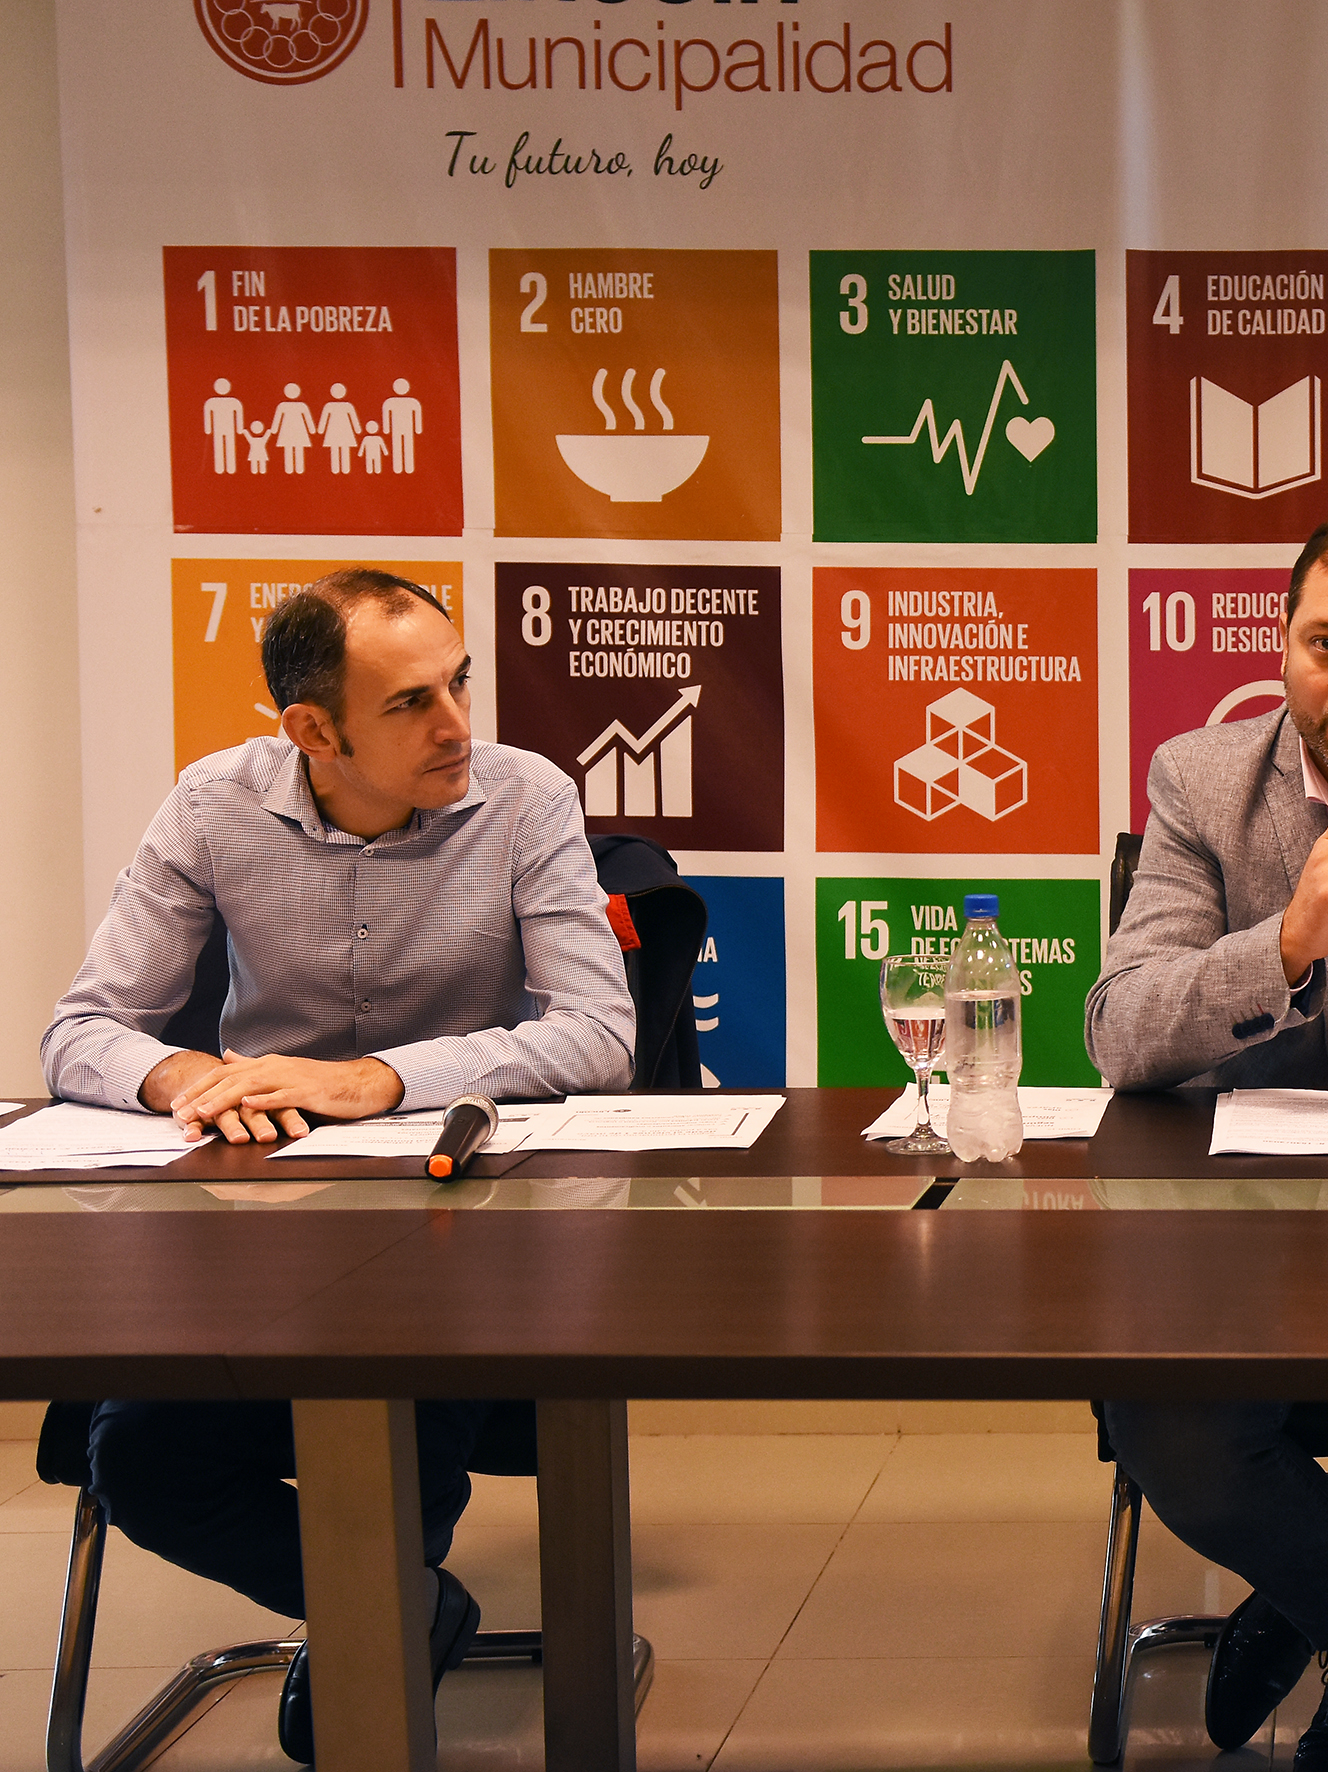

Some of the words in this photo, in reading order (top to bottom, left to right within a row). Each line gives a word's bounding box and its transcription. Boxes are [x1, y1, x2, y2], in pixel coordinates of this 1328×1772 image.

[424, 18, 954, 111] Municipalidad
[444, 130, 497, 177] Tu
[504, 130, 633, 189] futuro,
[653, 132, 724, 190] hoy
[232, 271, 266, 297] FIN
[569, 272, 655, 299] HAMBRE
[888, 274, 956, 301] SALUD
[1207, 270, 1324, 301] EDUCACIÓN
[197, 270, 218, 331] 1
[519, 272, 548, 333] 2
[839, 273, 869, 335] 3
[1152, 274, 1184, 335] 4
[233, 306, 260, 332] DE
[265, 306, 292, 332] LA
[296, 306, 393, 333] POBREZA
[570, 307, 623, 334] CERO
[888, 309, 903, 335] Y
[907, 309, 1018, 335] BIENESTAR
[1207, 309, 1233, 335] DE
[1237, 308, 1326, 335] CALIDAD
[200, 582, 228, 643] 7
[568, 586, 667, 615] TRABAJO
[670, 588, 759, 615] DECENTE
[888, 591, 1004, 619] INDUSTRIA,
[521, 585, 552, 647] 8
[840, 589, 871, 650] 9
[1142, 591, 1196, 652] 10
[568, 618, 583, 645] Y
[586, 619, 724, 647] CRECIMIENTO
[888, 620, 1013, 649] INNOVACIÓN
[1017, 623, 1029, 649] E
[569, 648, 692, 679] ECONÓMICO
[888, 655, 1082, 682] INFRAESTRUCTURA
[837, 900, 890, 960] 15
[910, 905, 958, 931] VIDA
